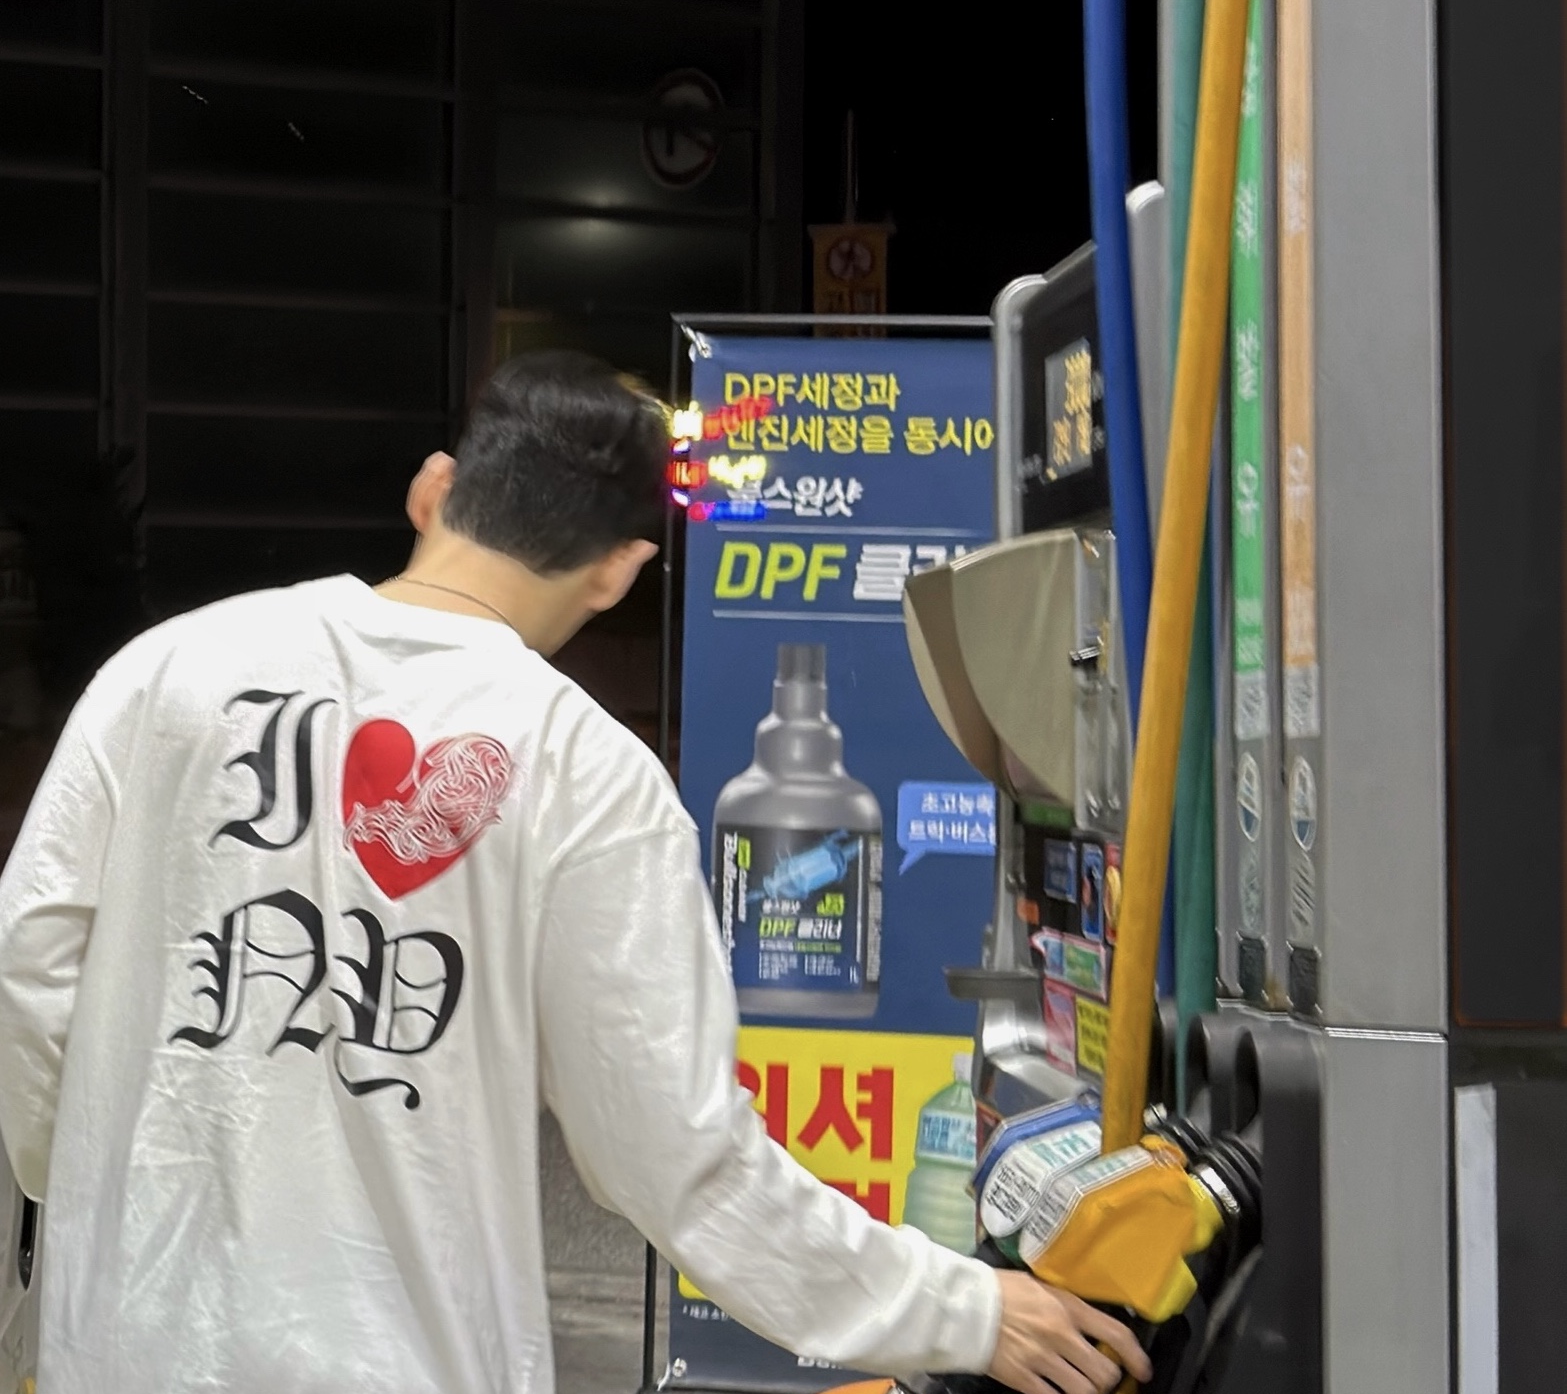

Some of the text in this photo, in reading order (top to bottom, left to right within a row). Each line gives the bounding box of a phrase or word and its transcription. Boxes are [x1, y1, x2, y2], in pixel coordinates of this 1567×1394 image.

[725, 372, 901, 412] DPF세정과
[715, 540, 848, 601] DPF
[759, 917, 796, 938] DPF
